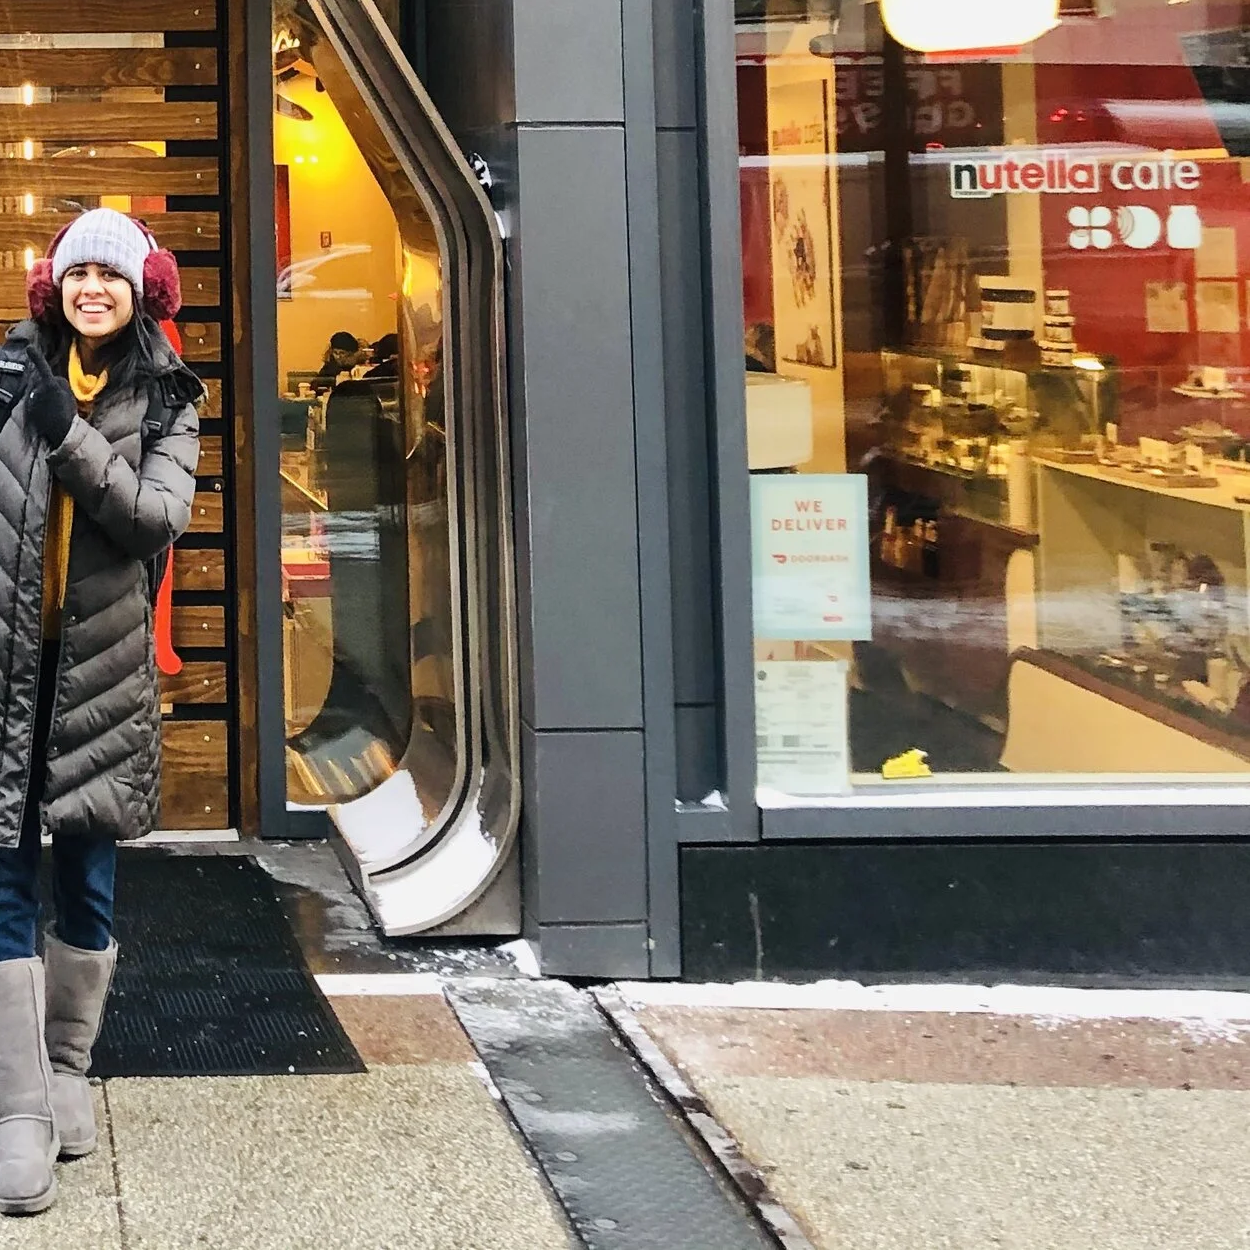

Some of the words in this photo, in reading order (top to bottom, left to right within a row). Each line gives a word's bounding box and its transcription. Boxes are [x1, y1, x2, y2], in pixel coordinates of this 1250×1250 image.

[953, 155, 1096, 190] nutella
[795, 500, 823, 513] WE
[771, 518, 847, 531] DELIVER
